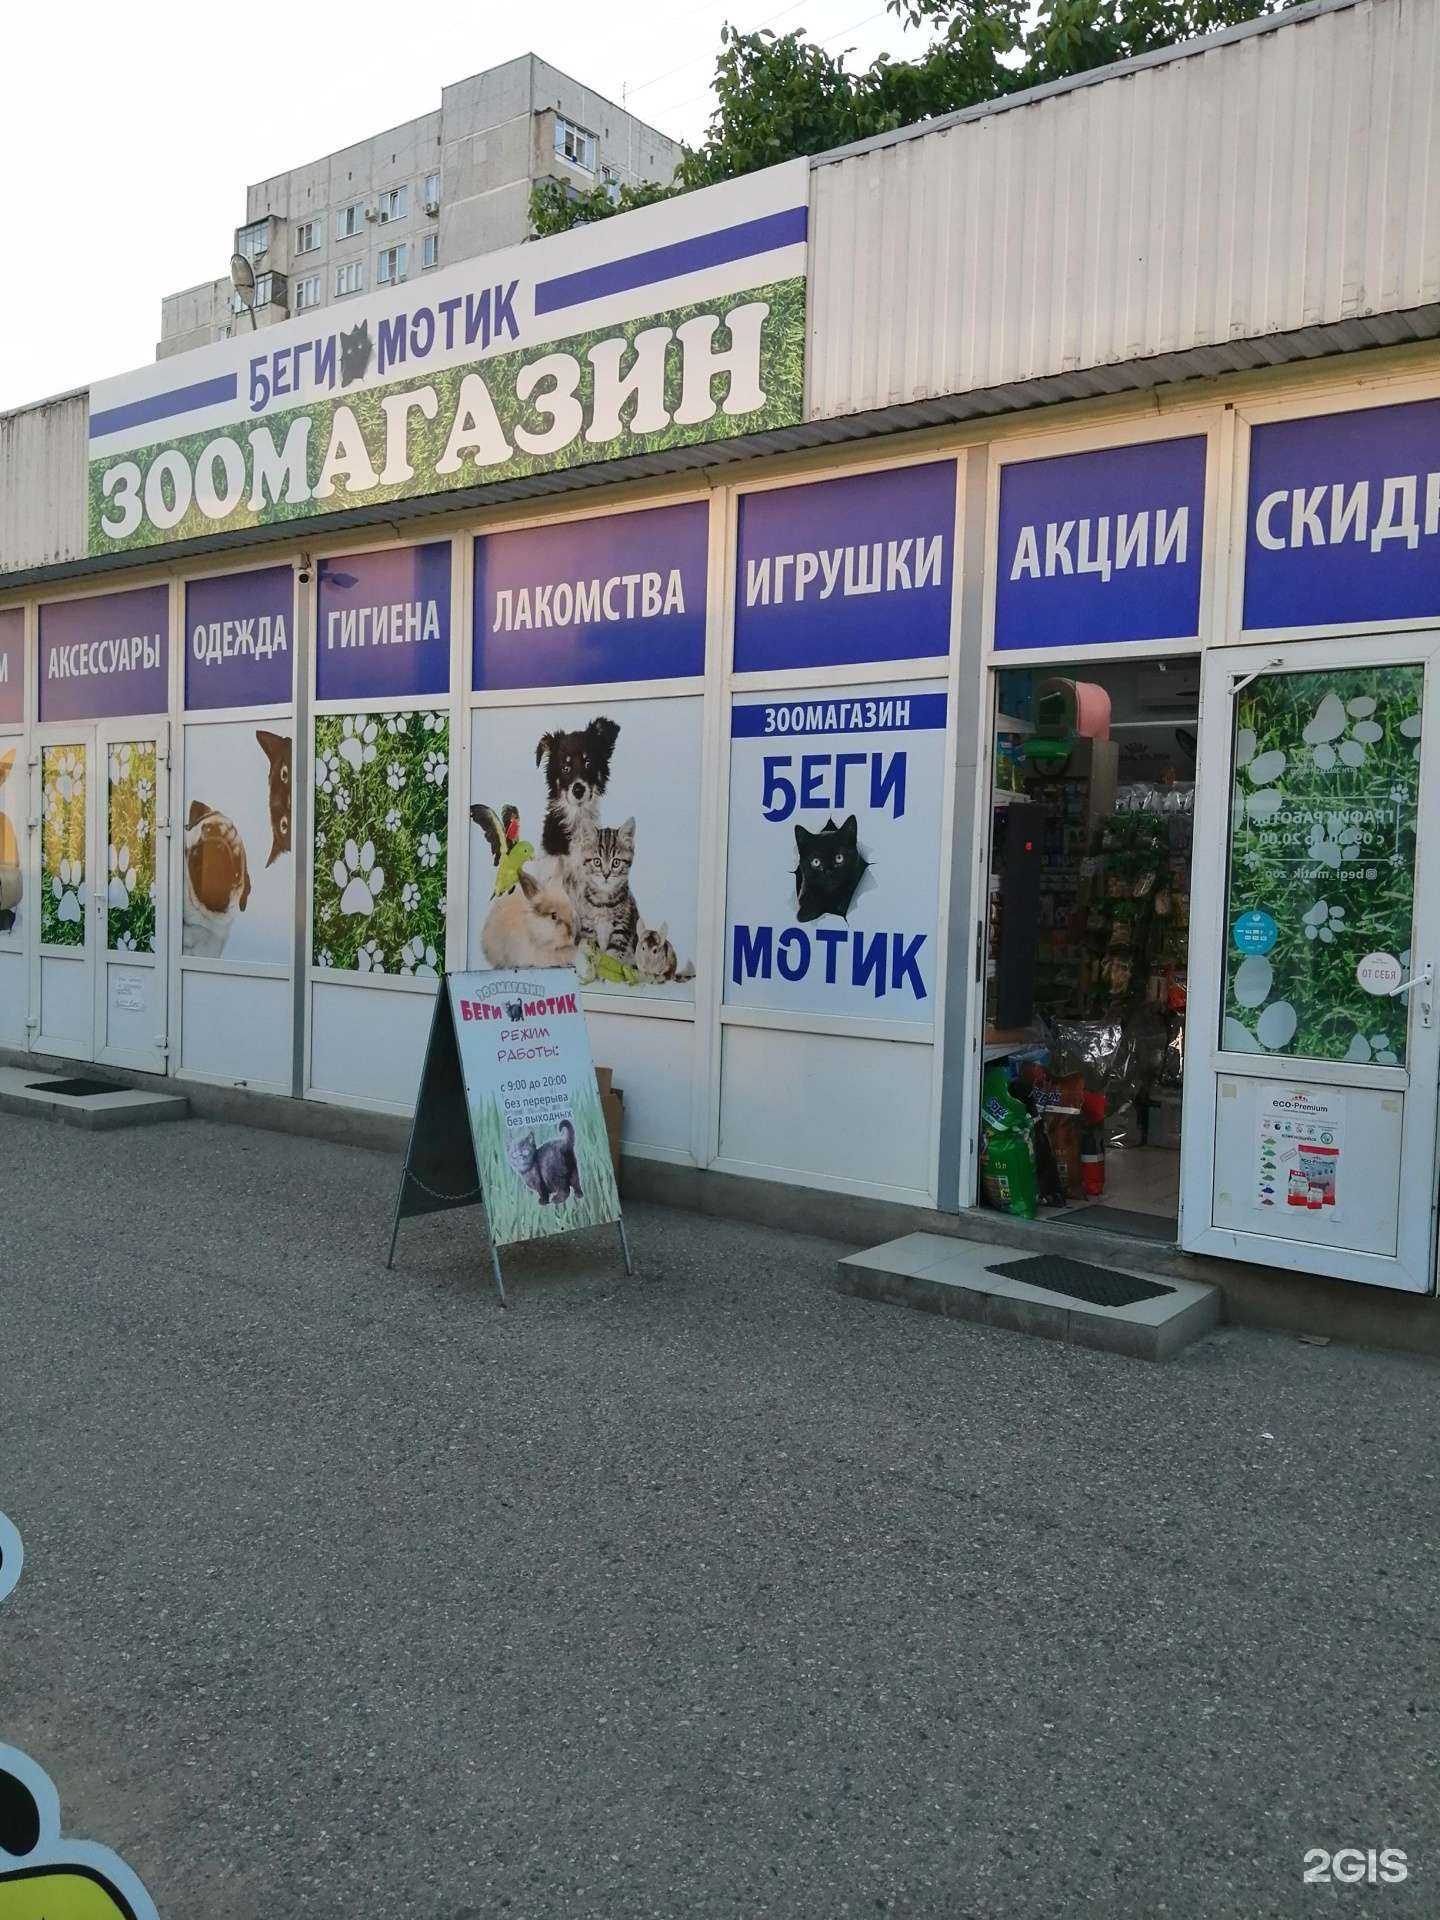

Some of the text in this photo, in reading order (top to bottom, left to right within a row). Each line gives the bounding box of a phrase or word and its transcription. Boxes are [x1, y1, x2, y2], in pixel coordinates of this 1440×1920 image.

[249, 279, 520, 412] БЕГИ МОТИК
[100, 302, 771, 540] ЗООМАГАЗИН
[1009, 506, 1190, 582] АКЦИИ
[745, 534, 943, 607] ИГРУШКИ
[327, 600, 440, 649] ГИГИЕНА
[492, 569, 685, 633] ЛАКОМСТВА
[48, 634, 161, 680] АКСЕССУАРЫ
[193, 614, 288, 666] ОДЕЖДА
[763, 699, 911, 734] ЗООМАГАЗИН
[761, 750, 907, 822] БЕГИ
[732, 925, 927, 1000] МОТИК
[460, 993, 578, 1022] БЕГИ МОТИК
[497, 1045, 559, 1062] РАБОТЫ:
[500, 1027, 550, 1042] РЕЖИМ
[500, 1074, 567, 1093] с 9:00 до 20:00
[504, 1093, 569, 1109] без перерыва
[506, 1110, 573, 1127] без выходных
